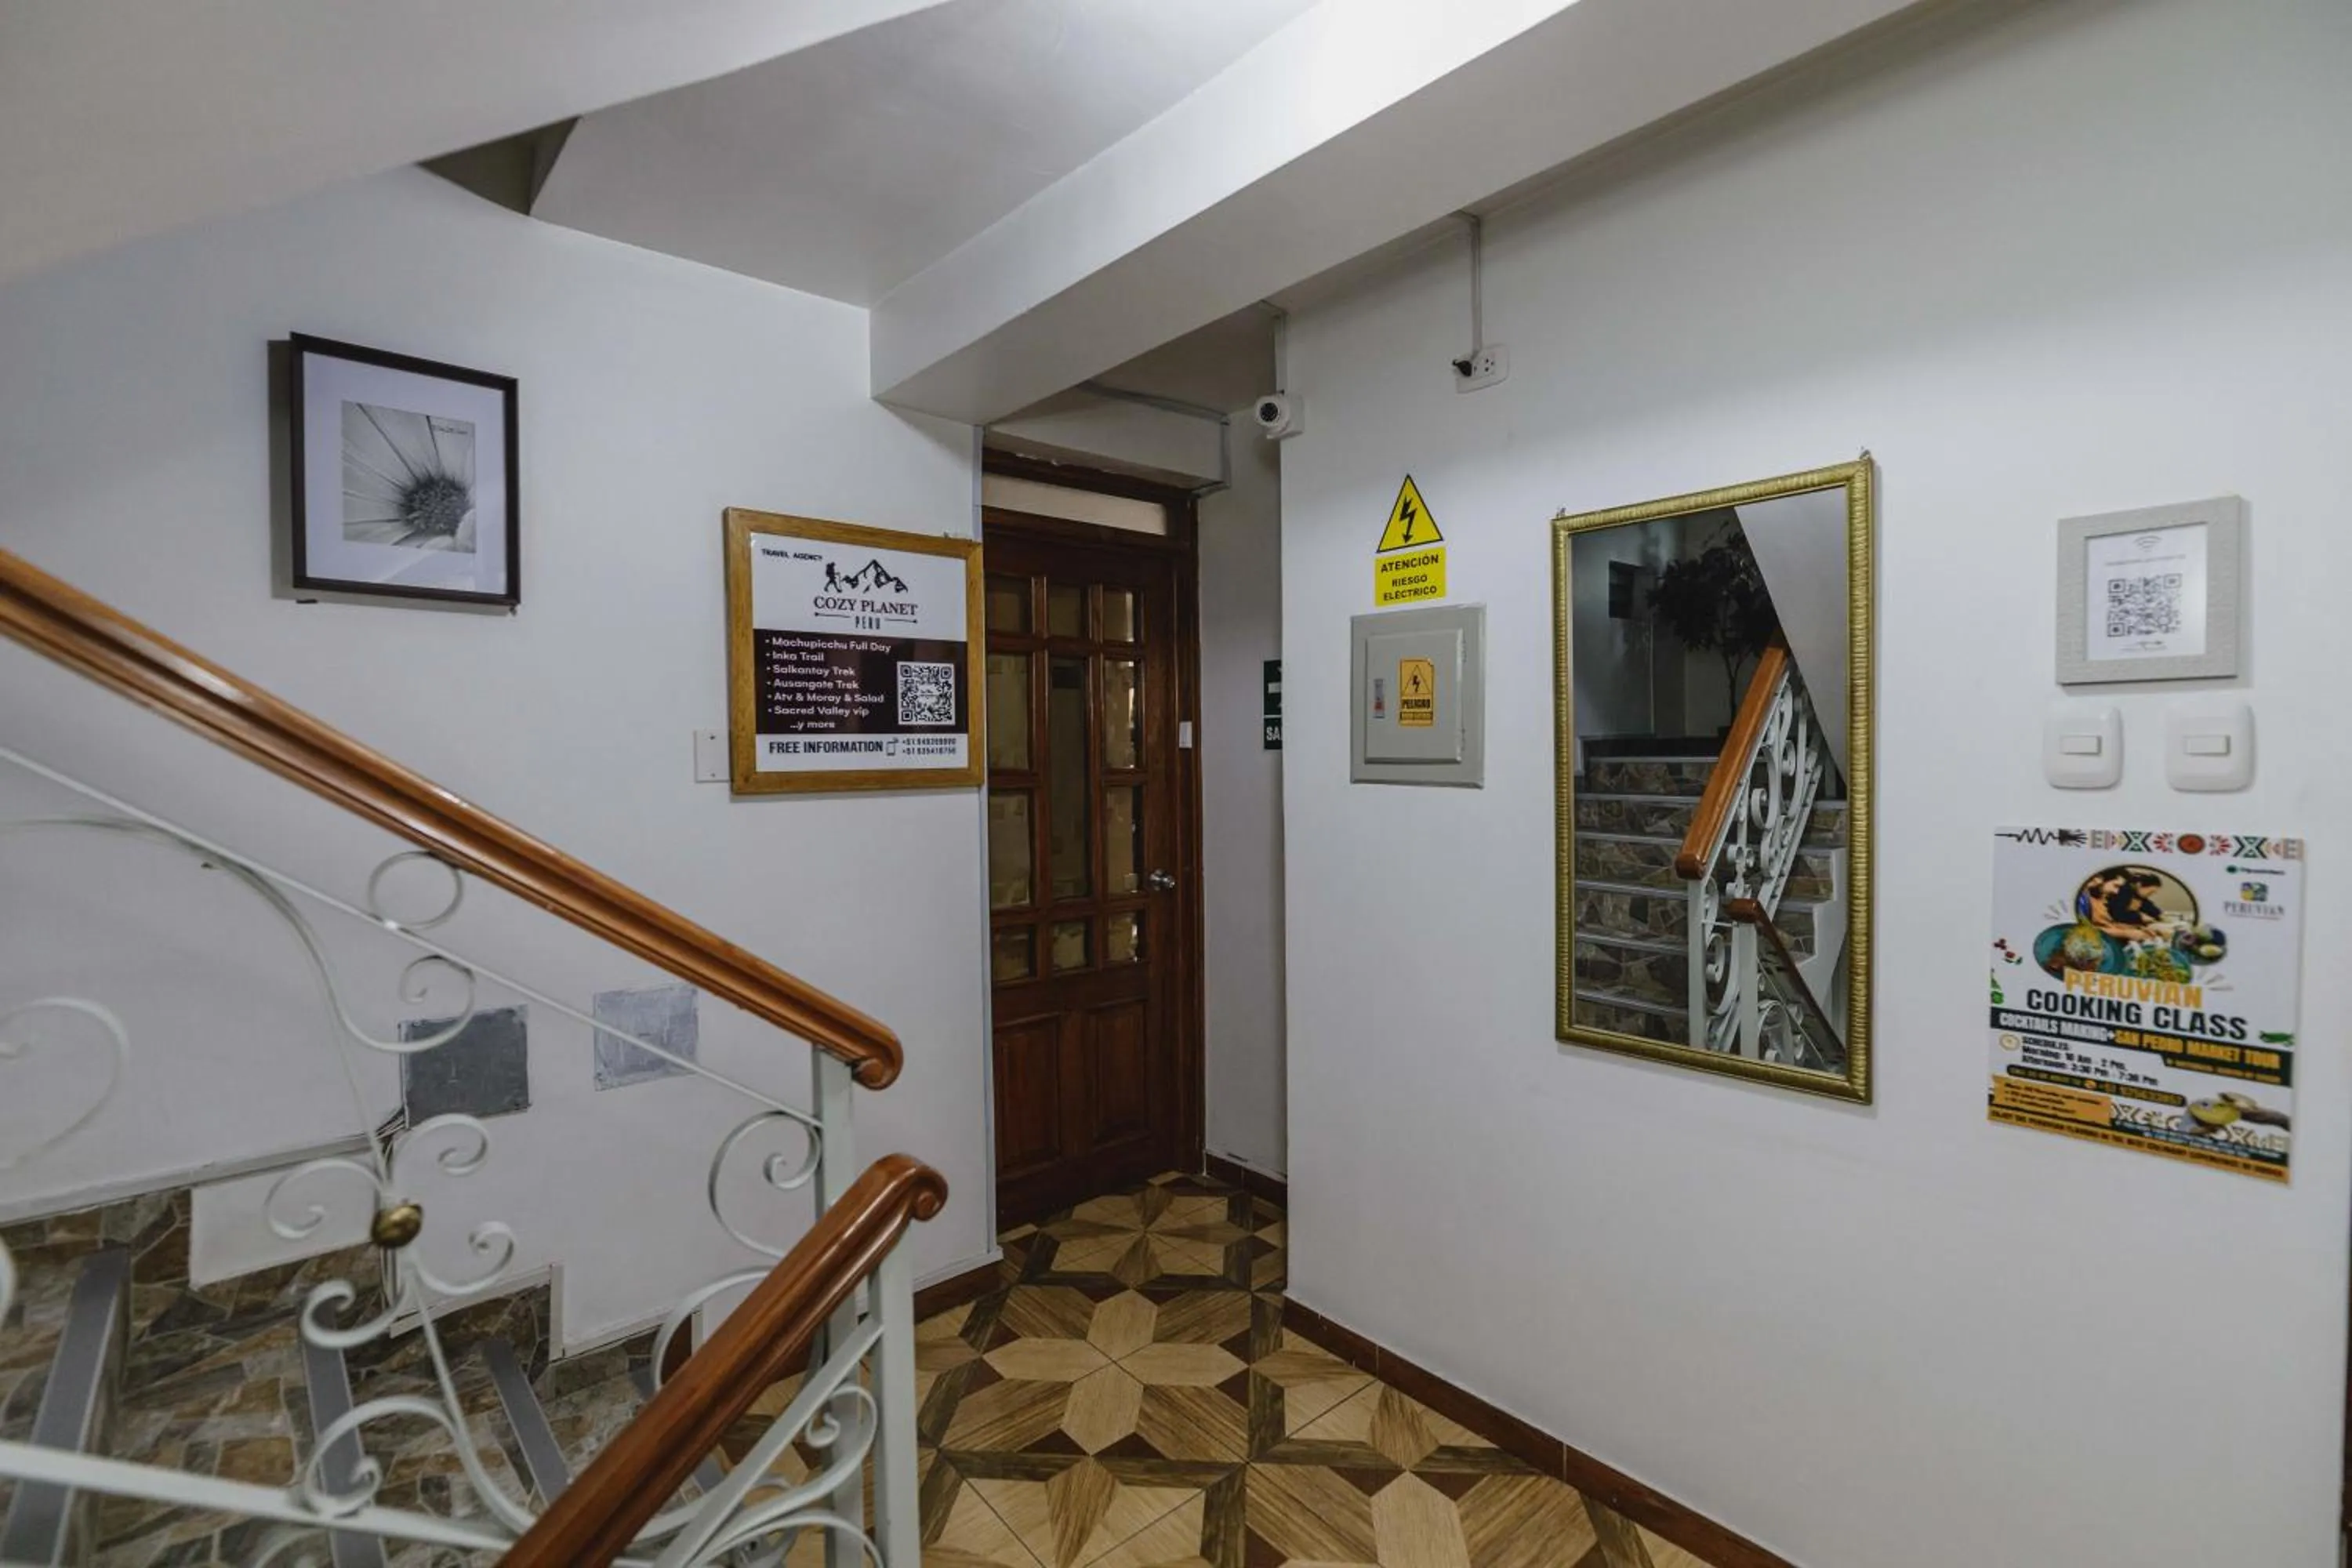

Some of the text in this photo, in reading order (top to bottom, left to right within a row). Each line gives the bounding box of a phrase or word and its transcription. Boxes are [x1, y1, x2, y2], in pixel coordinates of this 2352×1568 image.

[761, 548, 822, 561] TRAVEL AGENCY
[1392, 574, 1428, 587] RIESGO
[814, 596, 918, 615] COZY PLANET
[855, 615, 880, 630] PERU
[772, 637, 891, 654] Machupicchu Full Day
[772, 651, 824, 661] Inka Trail
[772, 664, 855, 677] Salkantay Trek
[773, 679, 860, 690] Ausangate Trek
[774, 692, 793, 702] Atv
[796, 692, 804, 702] &
[807, 693, 841, 704] Moray
[844, 693, 851, 702] &
[774, 706, 870, 718] Sacred Valley vip
[1266, 726, 1283, 741] SA
[769, 740, 883, 753] FREE INFORMATION
[2063, 967, 2202, 1009] PERUVIAN
[2027, 989, 2248, 1040] COOKING CLASS
[1999, 1013, 2058, 1033] COCKTAILS
